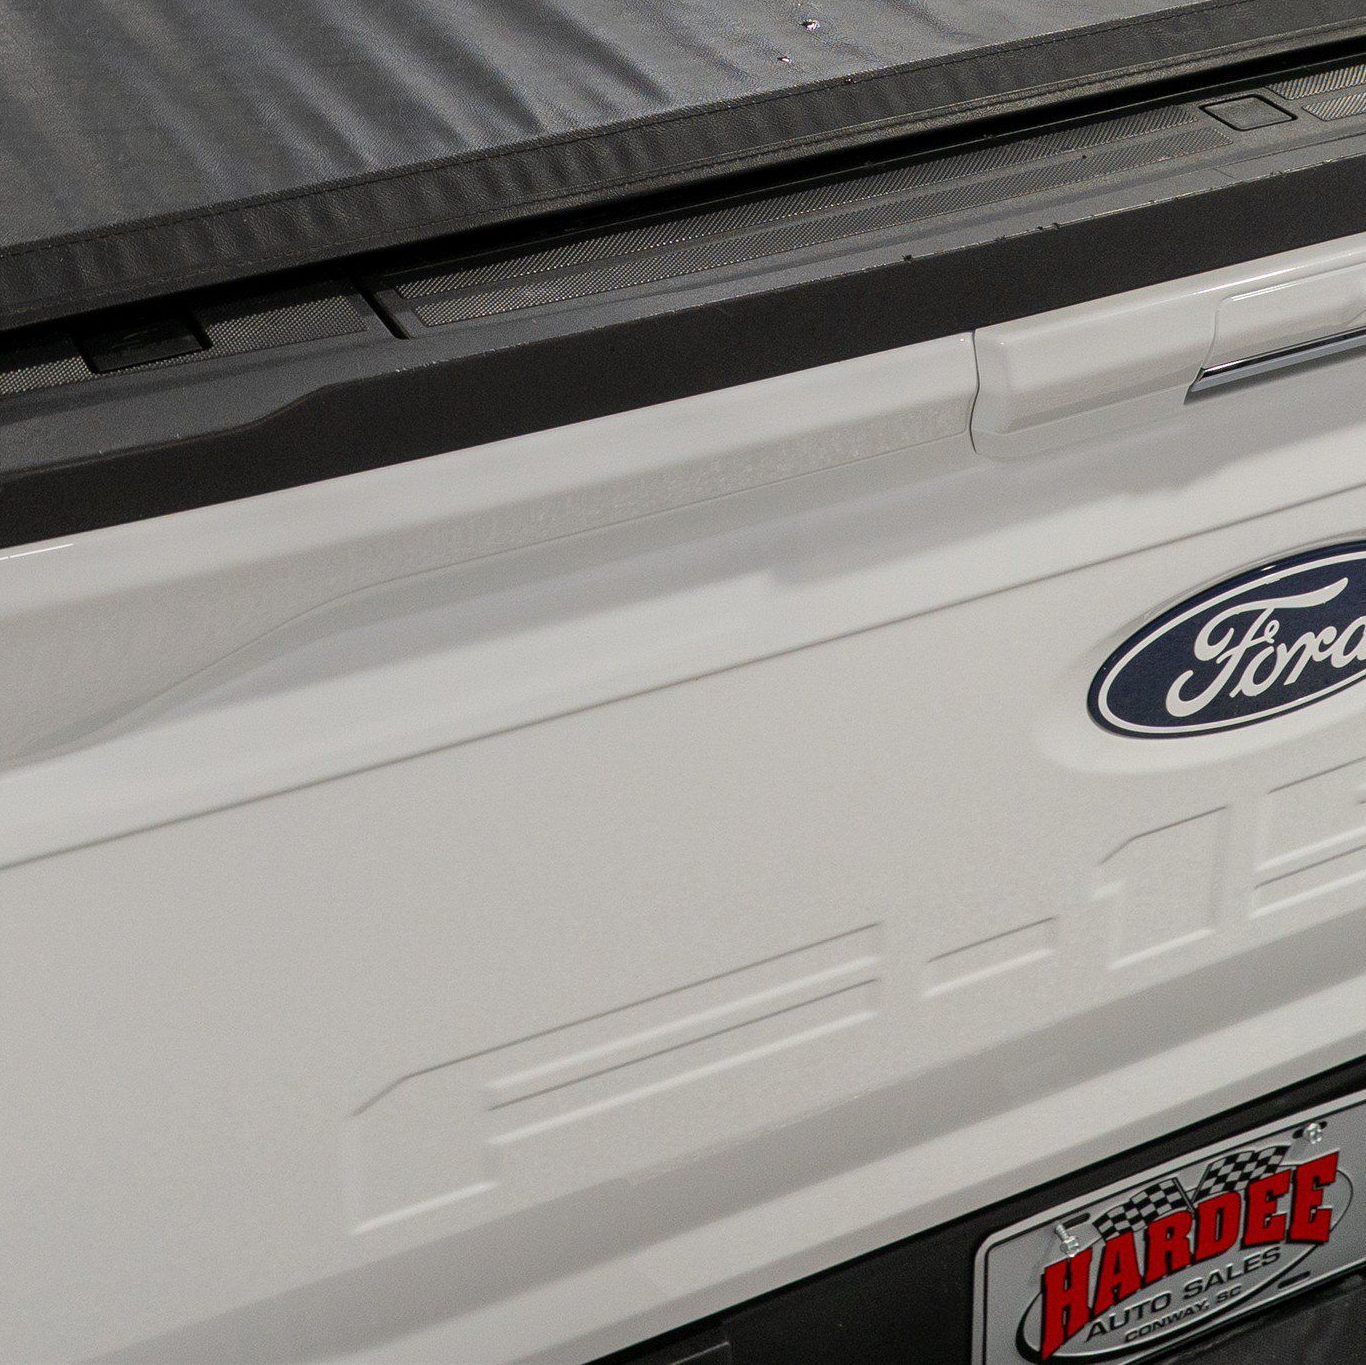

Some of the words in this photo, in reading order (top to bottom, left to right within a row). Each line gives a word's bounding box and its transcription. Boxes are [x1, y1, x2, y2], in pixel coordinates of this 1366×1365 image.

[1039, 1150, 1340, 1361] HARDEE
[1085, 1290, 1172, 1343] AUTO
[1182, 1245, 1281, 1301] SALES
[1124, 1298, 1210, 1344] CONWAY,
[1216, 1284, 1242, 1305] SC
